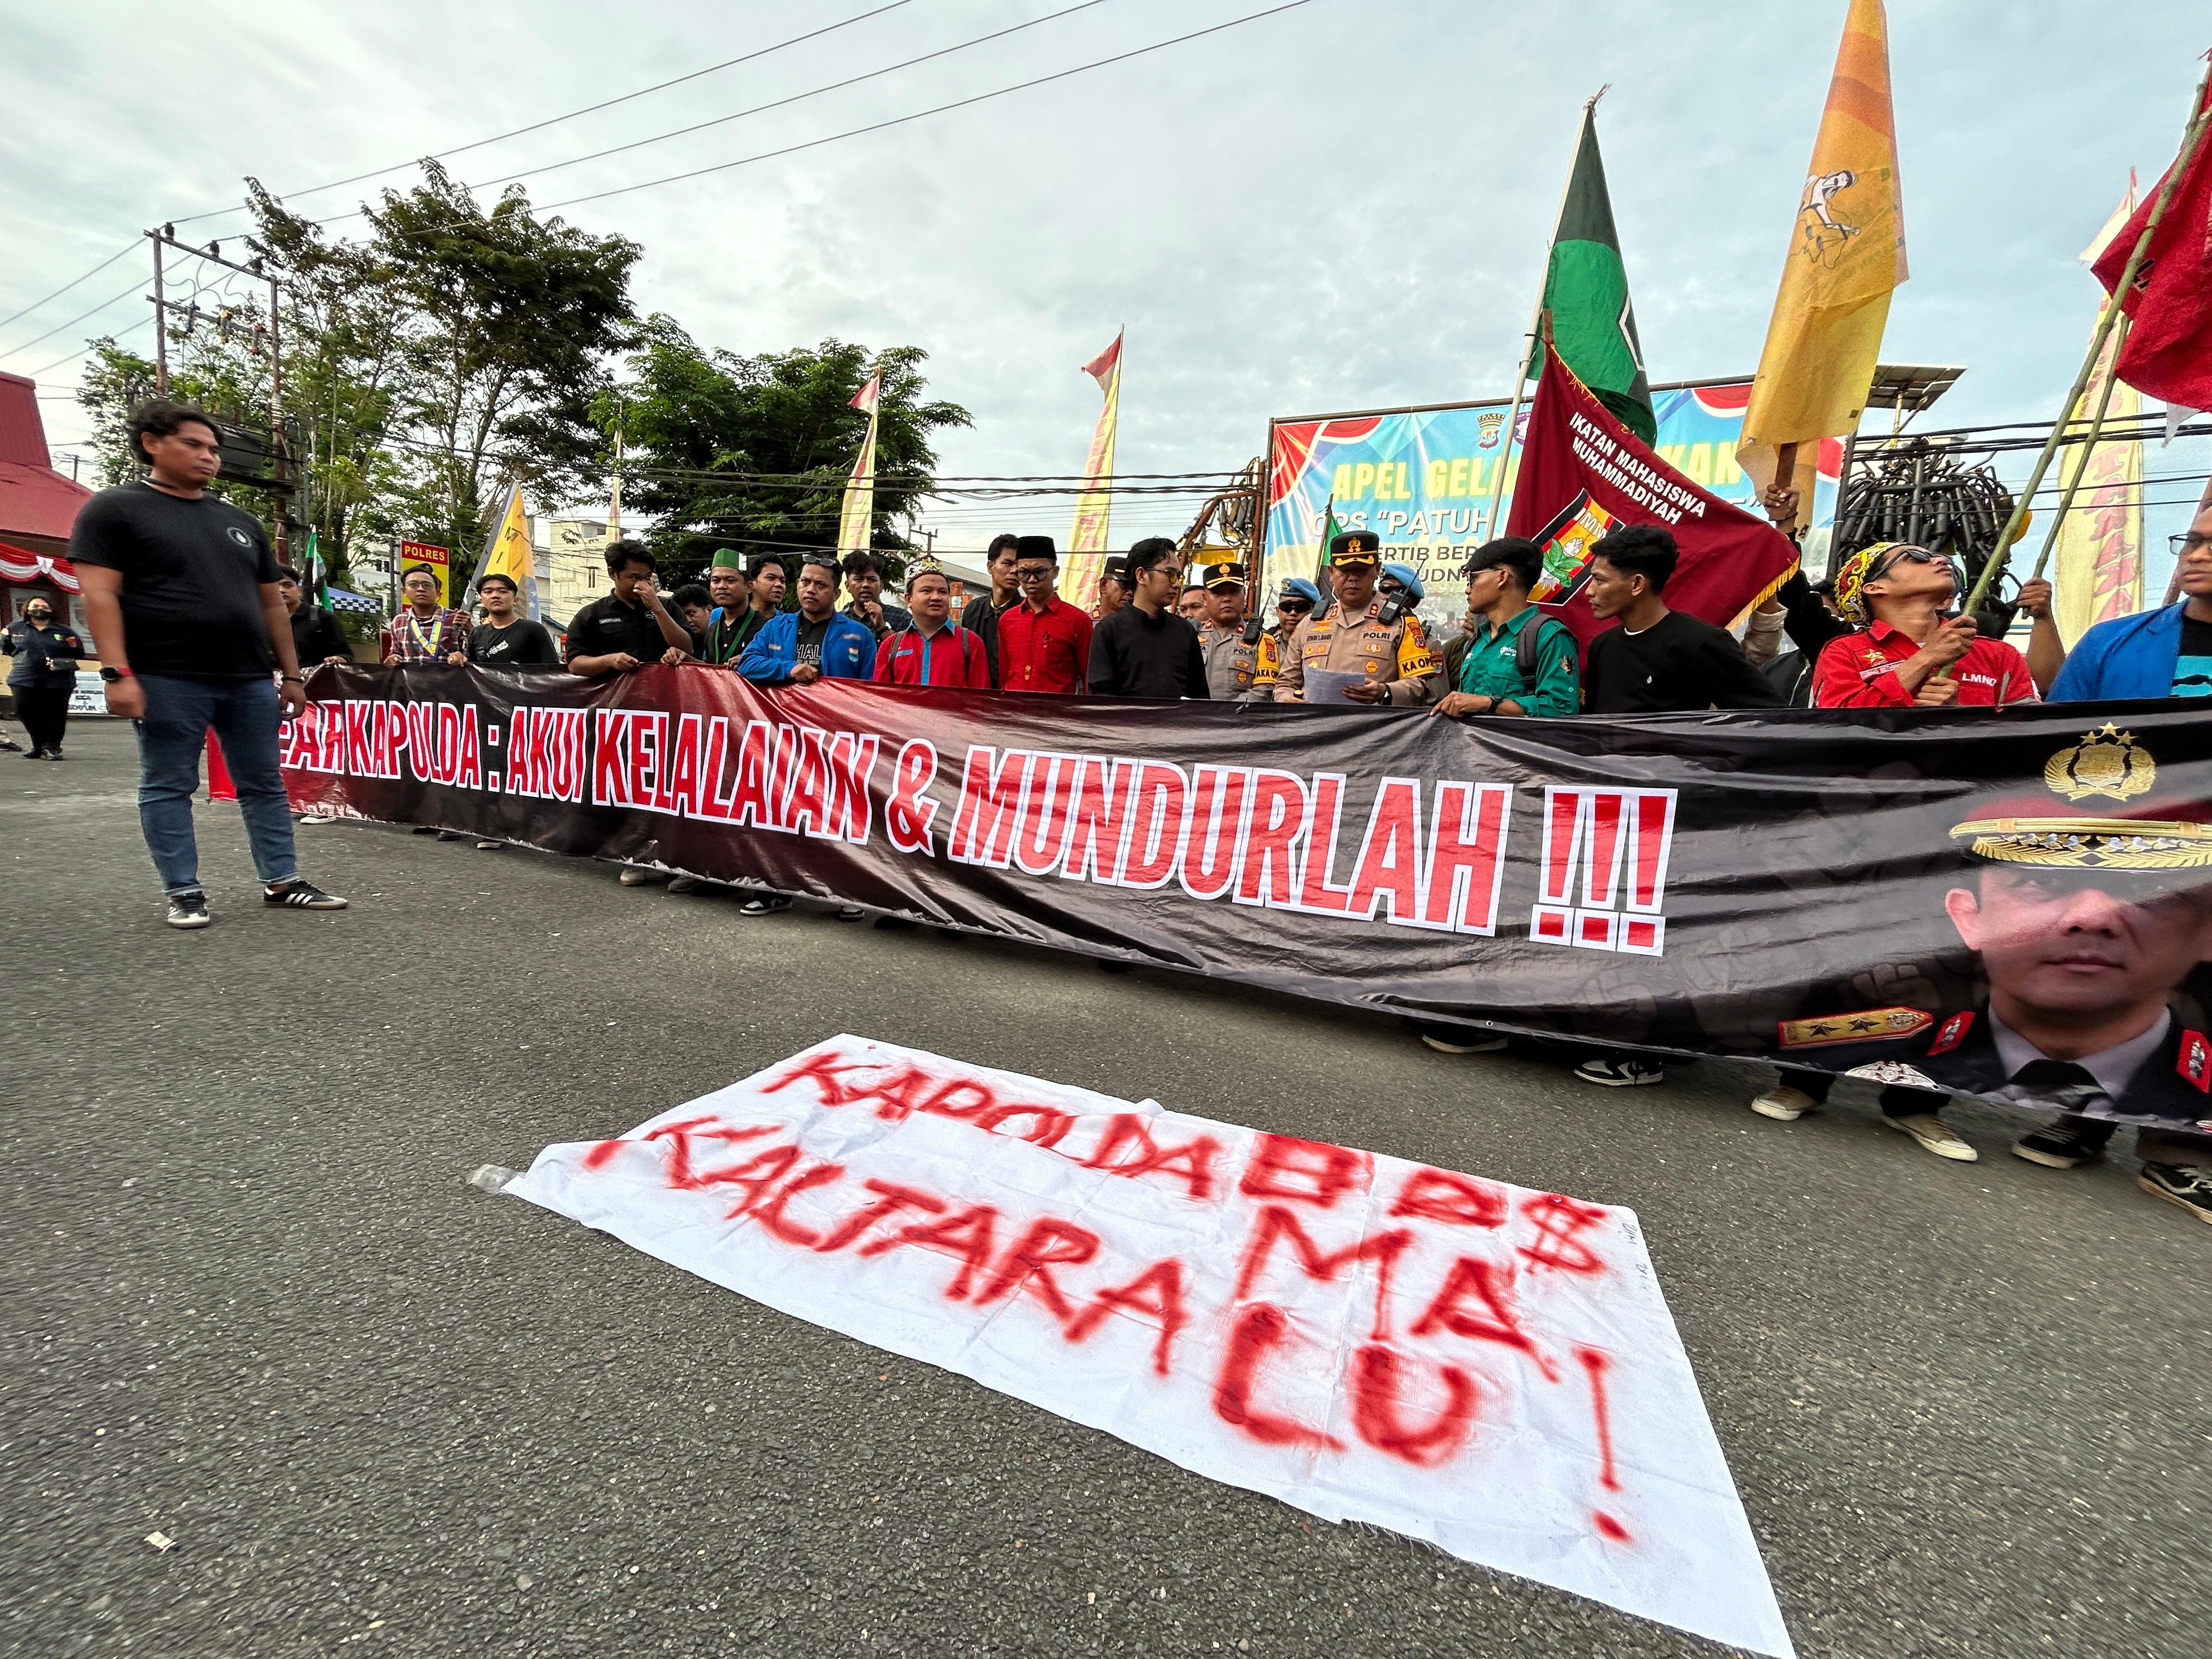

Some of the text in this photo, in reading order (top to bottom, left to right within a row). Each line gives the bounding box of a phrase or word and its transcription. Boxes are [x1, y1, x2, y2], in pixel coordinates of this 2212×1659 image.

[1331, 461, 1412, 501] APEL
[1426, 454, 1521, 500] GELA
[1569, 411, 1707, 517] IKATAN MAHASISWA
[1572, 437, 1683, 525] MUHAMMADIYAH
[1573, 507, 1607, 540] IMM
[404, 545, 445, 561] POLRES
[1233, 648, 1256, 657] POLRI
[1402, 662, 1417, 673] KA
[345, 699, 482, 790] KAPOLDA
[505, 706, 588, 803] AKUI
[592, 708, 880, 845] KELALAIAN
[885, 737, 939, 857] &
[947, 744, 1514, 938] MUNDURLAH
[1529, 785, 1679, 957] !!!
[761, 1051, 1226, 1201] KAPOLDA
